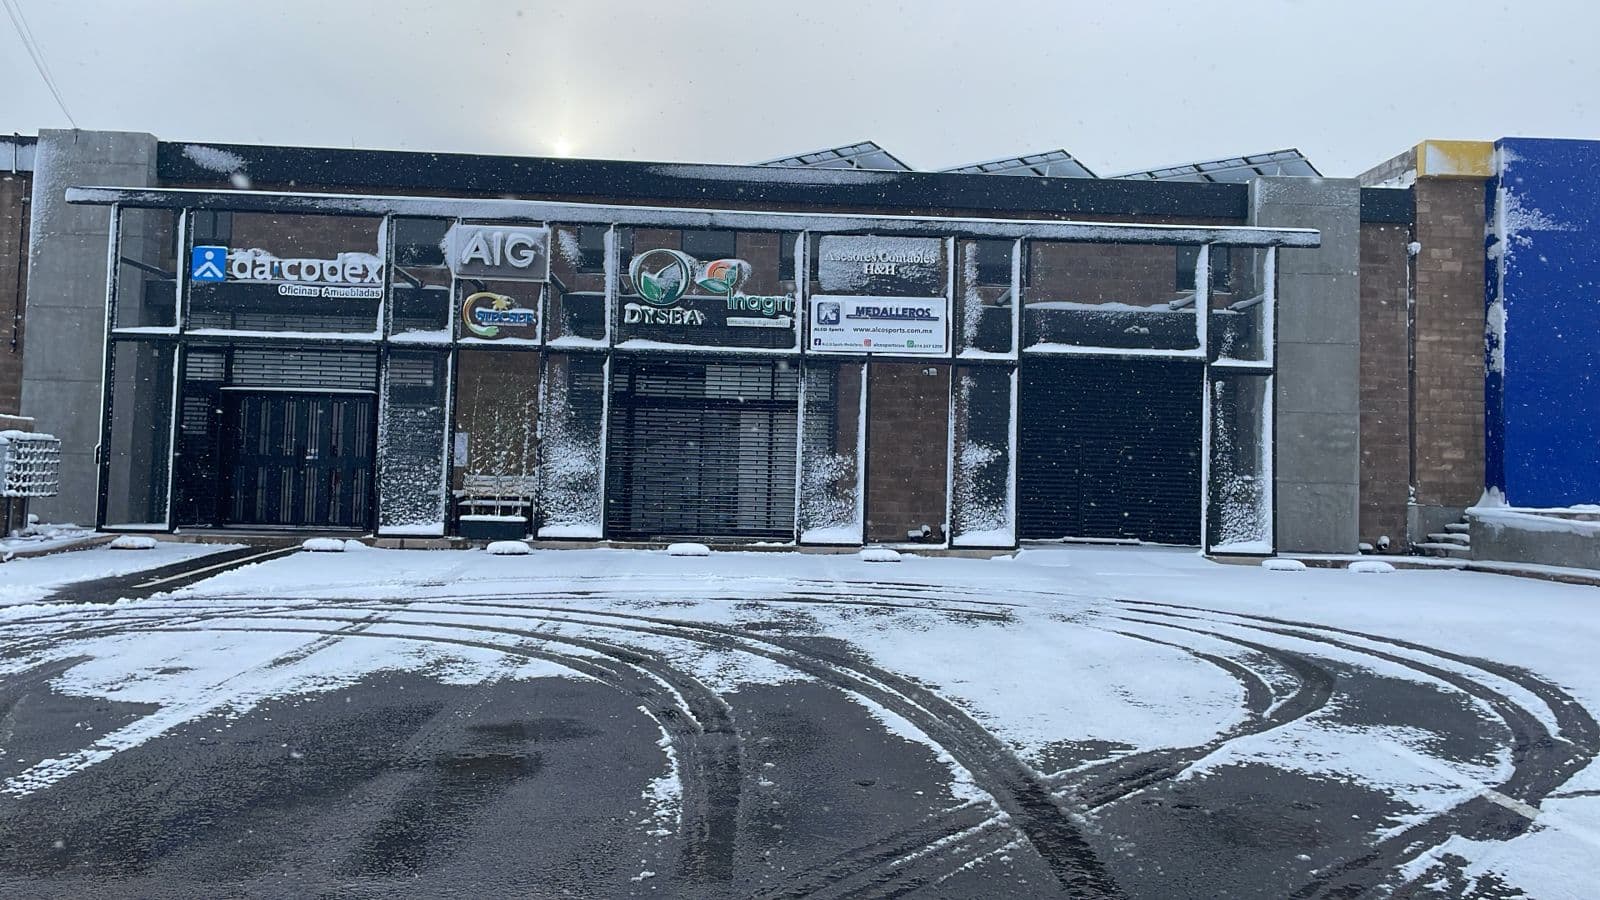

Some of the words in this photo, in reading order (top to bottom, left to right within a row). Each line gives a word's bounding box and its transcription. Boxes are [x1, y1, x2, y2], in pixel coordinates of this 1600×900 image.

[461, 231, 536, 268] AIG
[824, 251, 877, 262] Asesores
[879, 252, 936, 264] Contables
[864, 262, 897, 275] H&H
[279, 285, 318, 296] Oficinas
[323, 286, 380, 298] Amuebladas
[855, 306, 932, 318] MEDALLEROS
